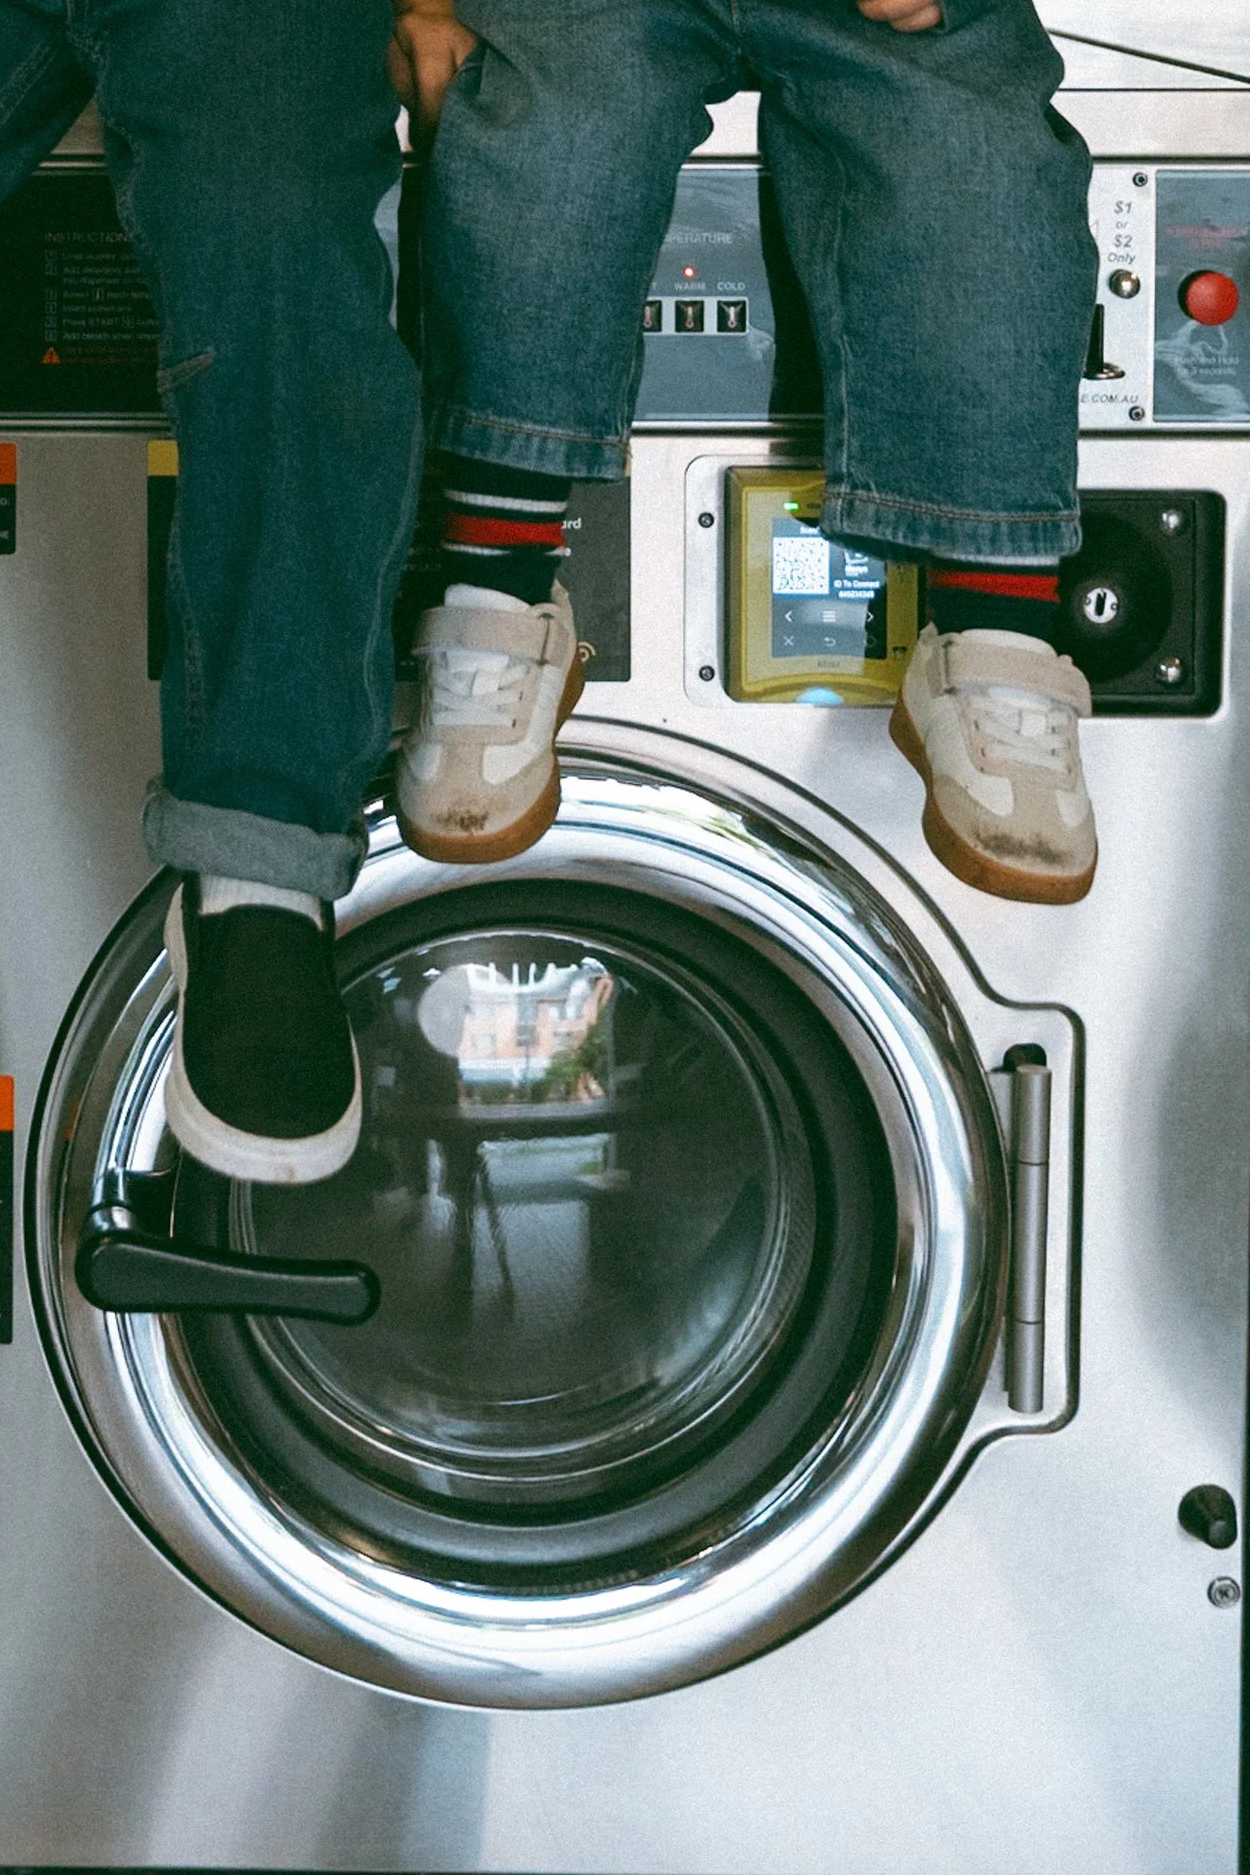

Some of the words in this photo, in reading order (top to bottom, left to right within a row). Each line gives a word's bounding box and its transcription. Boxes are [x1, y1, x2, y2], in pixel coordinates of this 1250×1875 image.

[1113, 200, 1134, 215] $1
[1115, 221, 1129, 230] or
[1113, 234, 1134, 249] $2
[1107, 252, 1136, 265] Only
[716, 281, 746, 291] COLD
